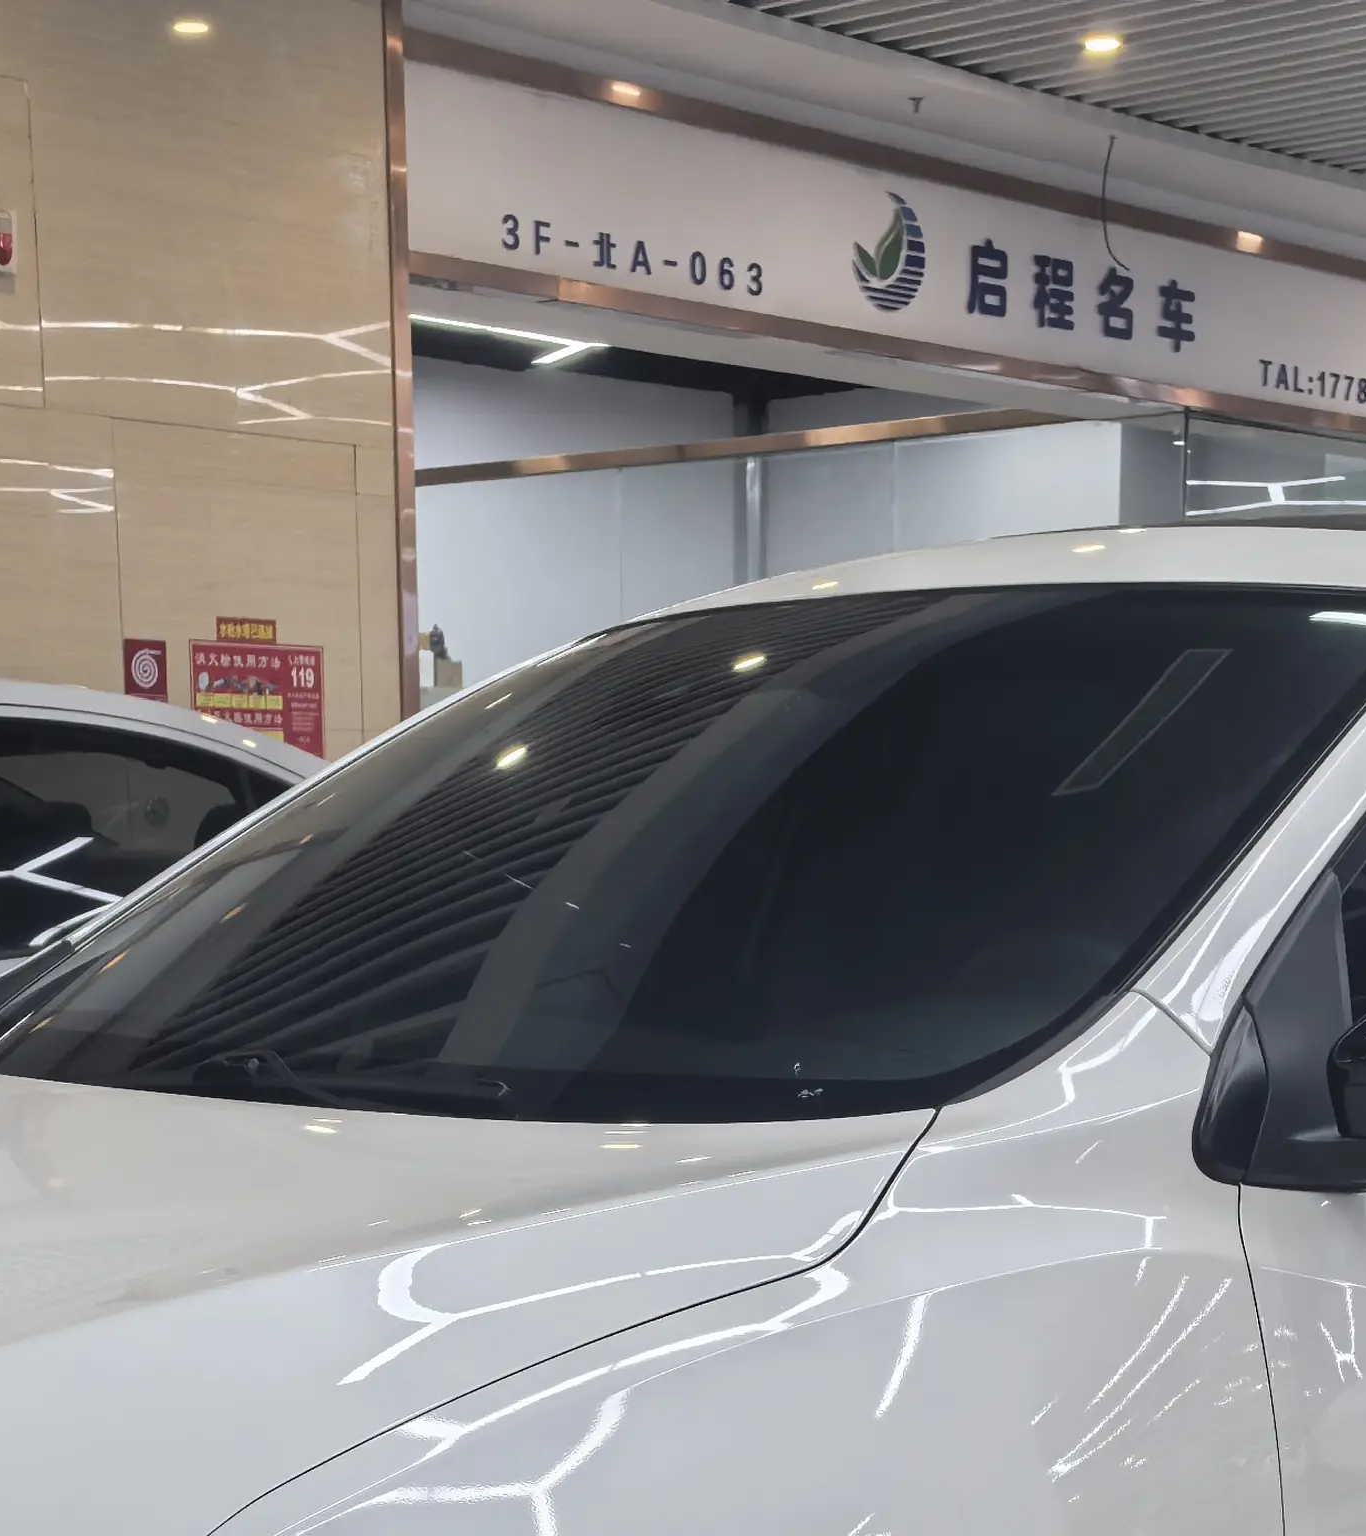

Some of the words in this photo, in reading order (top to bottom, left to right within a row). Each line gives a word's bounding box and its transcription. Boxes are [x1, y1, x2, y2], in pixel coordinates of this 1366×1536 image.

[967, 239, 1196, 352] 启程名车
[291, 667, 315, 688] 119
